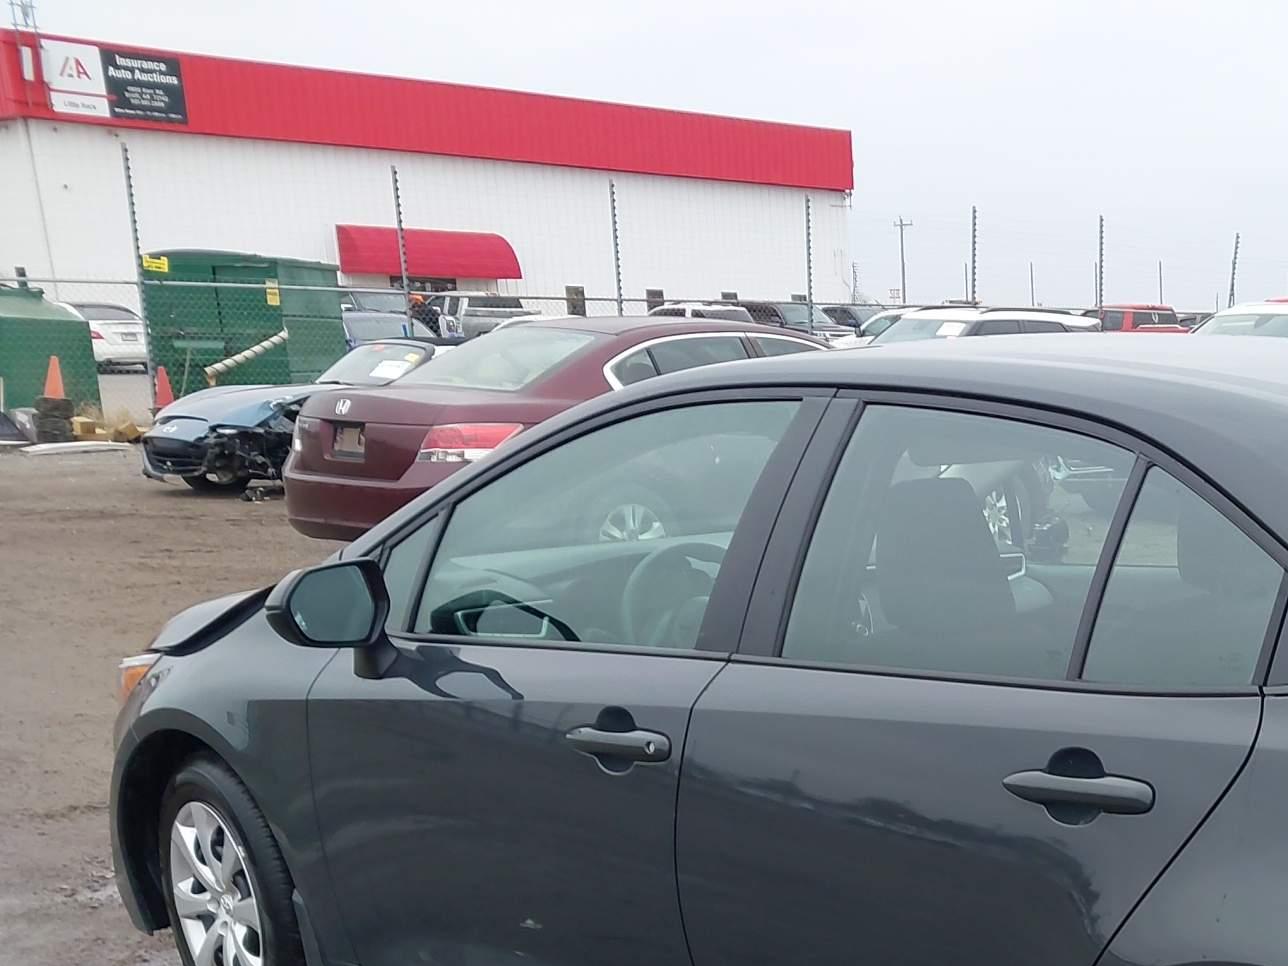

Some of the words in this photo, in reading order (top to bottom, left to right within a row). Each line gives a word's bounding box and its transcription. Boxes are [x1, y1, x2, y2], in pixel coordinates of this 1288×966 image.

[115, 54, 166, 71] Insurance
[108, 66, 132, 79] Auto
[134, 69, 178, 84] Auctions
